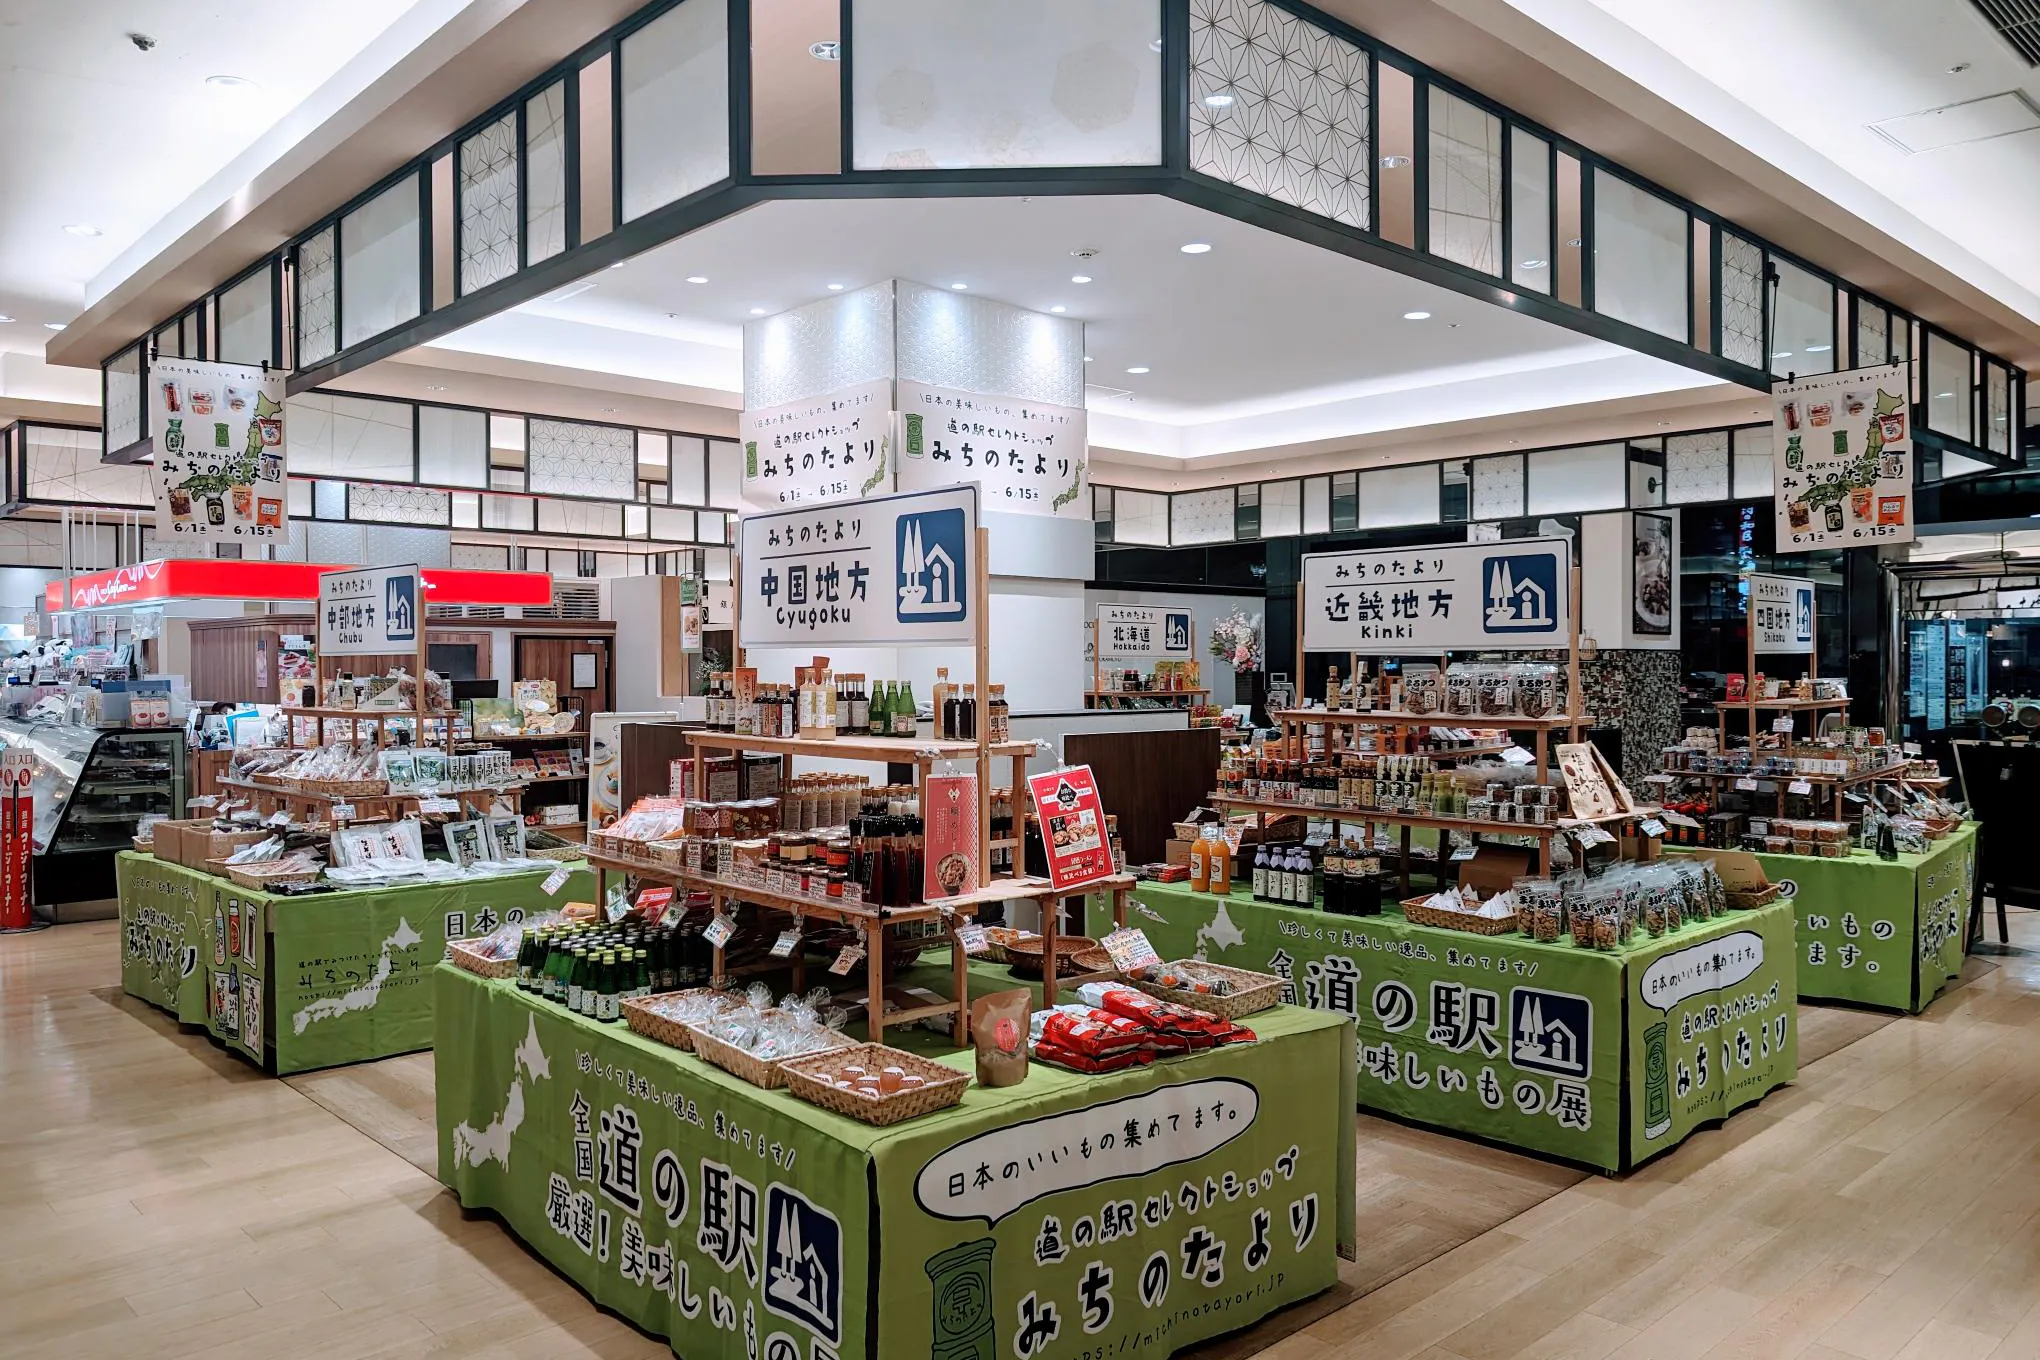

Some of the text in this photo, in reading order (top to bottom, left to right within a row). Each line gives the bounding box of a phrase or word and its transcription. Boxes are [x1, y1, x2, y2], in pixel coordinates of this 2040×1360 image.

[774, 418, 860, 449] 道の駅セレクトショップ
[947, 417, 1054, 446] 道の駅セレクトショップ
[162, 460, 280, 480] みちのたより
[764, 439, 874, 478] みちのたより
[932, 440, 1069, 477] みちのたより
[1783, 464, 1904, 489] みちのたより
[768, 518, 863, 548] みちのたより
[1335, 559, 1444, 579] みちのたより
[332, 579, 372, 594] みちのたより
[760, 560, 870, 608] 中国地方
[328, 603, 375, 631] 中部地方
[776, 605, 852, 630] Cyugoku
[1111, 610, 1153, 620] みちのたより
[1325, 589, 1453, 622] 近畿地方
[1757, 607, 1791, 630] 四国地方
[339, 631, 363, 643] Chubu
[1114, 626, 1150, 642] 北海道
[1361, 624, 1413, 639] Kinki
[1764, 632, 1786, 643] Shikoku
[1113, 643, 1150, 651] Hokkaido
[17, 754, 33, 765] 入口
[1810, 914, 1893, 938] いもの
[1809, 943, 1877, 971] ます。
[300, 960, 419, 988] みちのたより
[1306, 957, 1499, 1057] 道の駅
[1360, 1044, 1590, 1128] 味しいもの展
[571, 1091, 594, 1180] 全国
[948, 1100, 1238, 1198] 日本のいいもの集めてます。
[599, 1107, 757, 1285] 道の駅
[1038, 1147, 1298, 1263] 道の駅セレクトショップ
[1019, 1197, 1317, 1355] みちのたより
